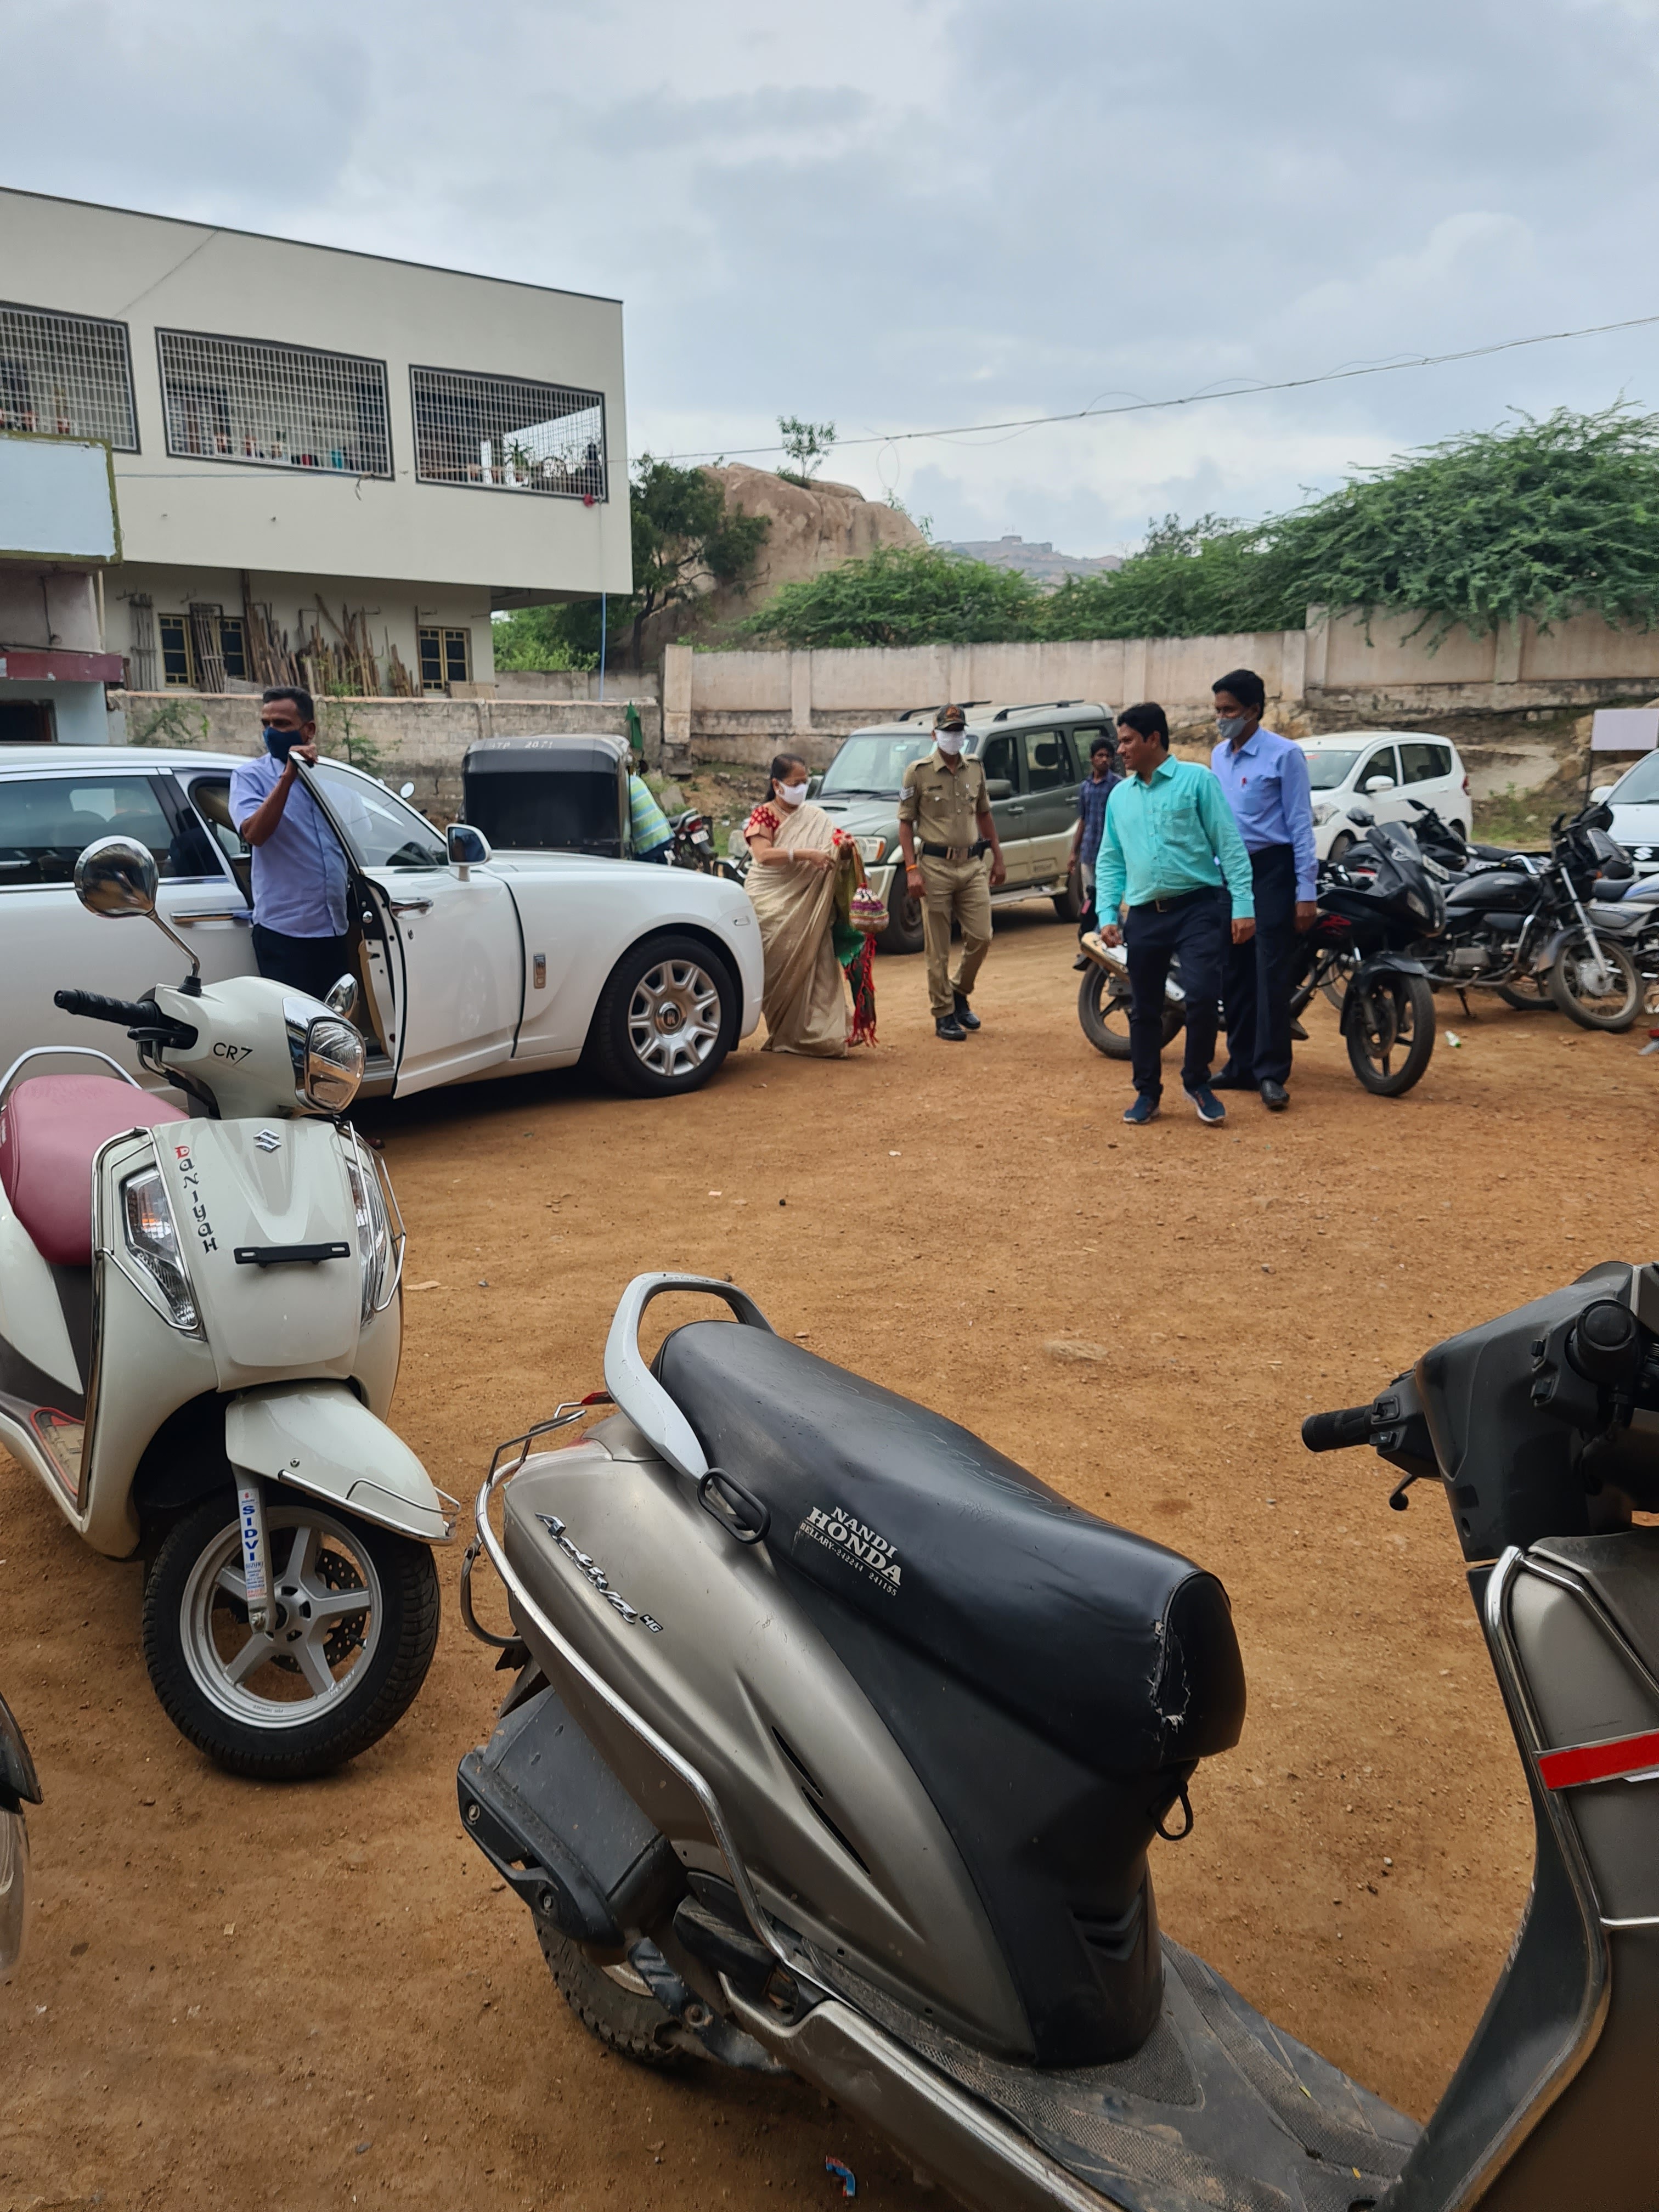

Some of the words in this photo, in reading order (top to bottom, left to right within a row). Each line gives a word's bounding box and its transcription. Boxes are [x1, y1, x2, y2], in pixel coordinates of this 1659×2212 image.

[213, 1042, 253, 1067] CR7
[242, 1505, 259, 1562] SIDVI
[806, 1506, 901, 1587] HONDA
[831, 1506, 898, 1559] NANDI
[534, 1512, 638, 1624] Activa
[642, 1615, 663, 1633] 4G
[868, 1572, 898, 1596] 241155
